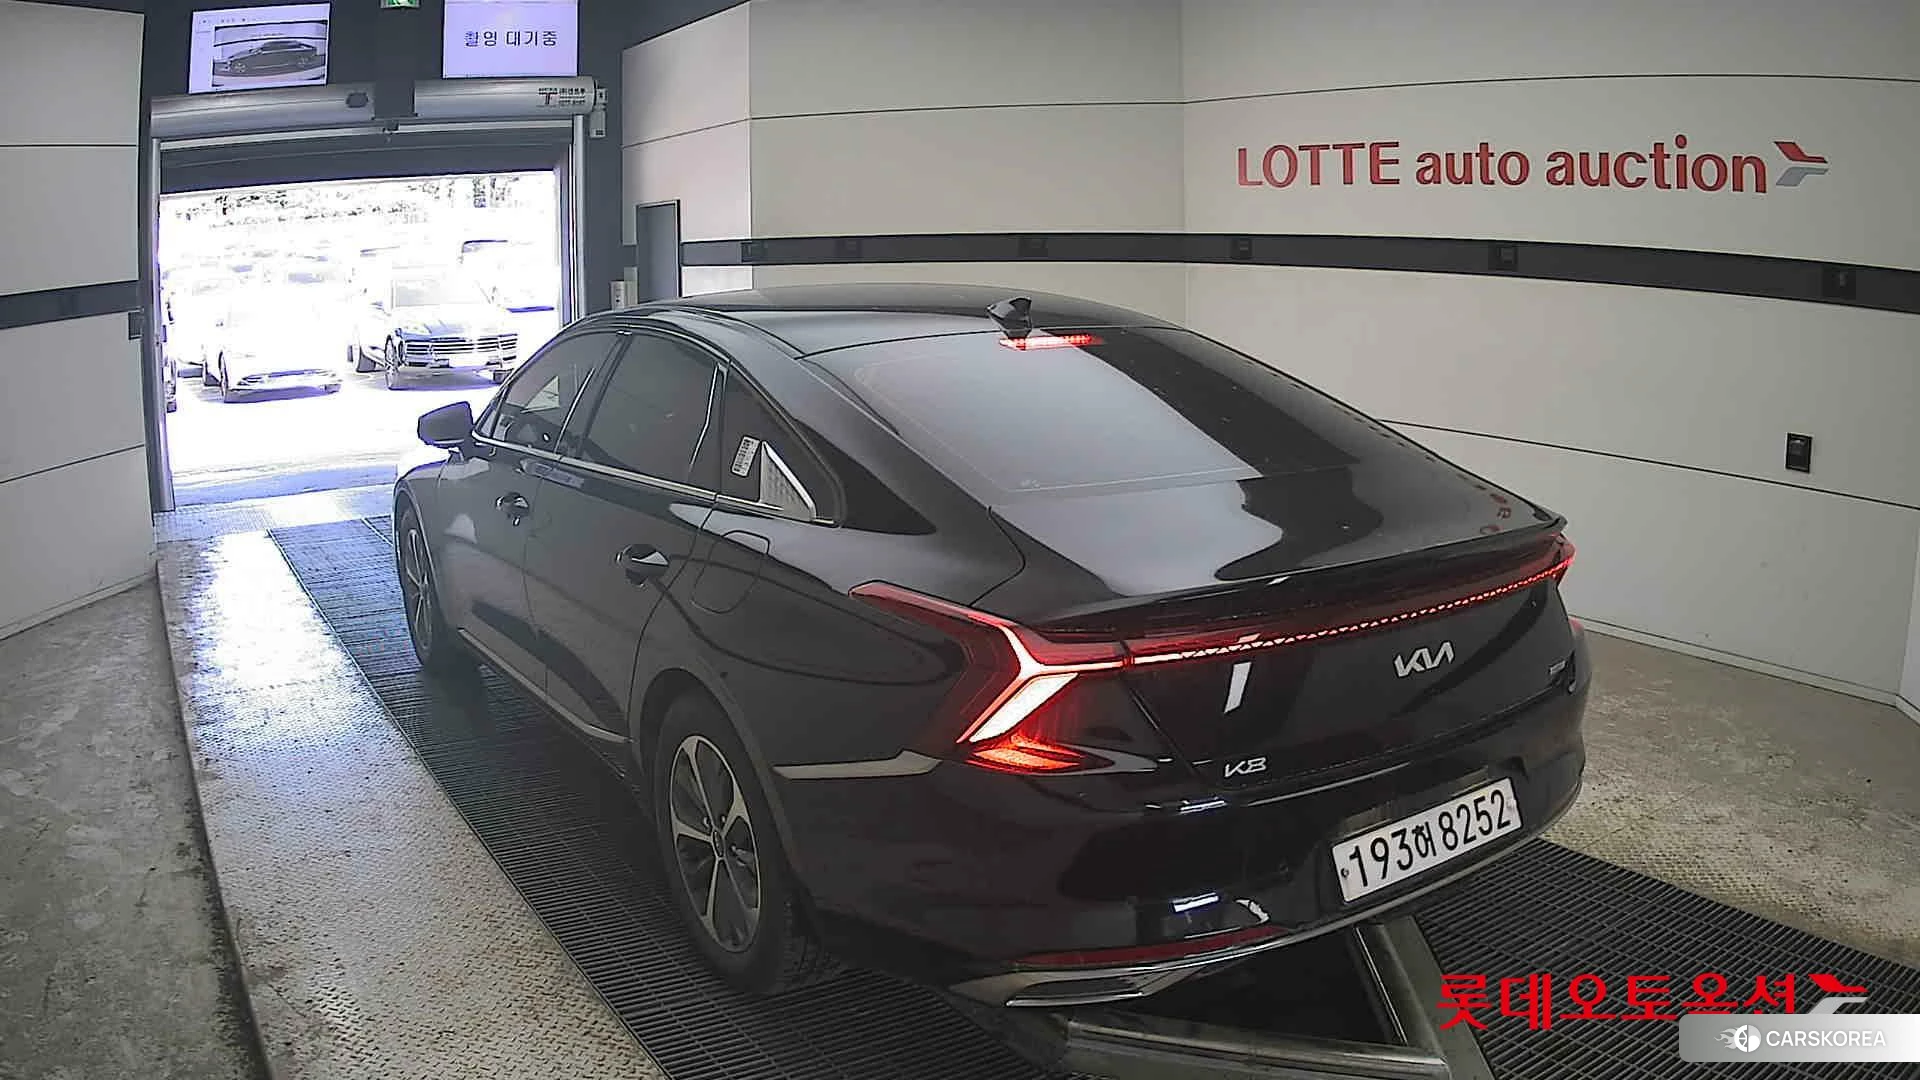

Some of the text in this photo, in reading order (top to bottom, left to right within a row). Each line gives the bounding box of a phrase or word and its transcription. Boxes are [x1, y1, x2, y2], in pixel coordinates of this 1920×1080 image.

[506, 31, 557, 47] 대기중
[1237, 135, 1767, 194] LOTTE auto auction
[1224, 757, 1267, 778] K8
